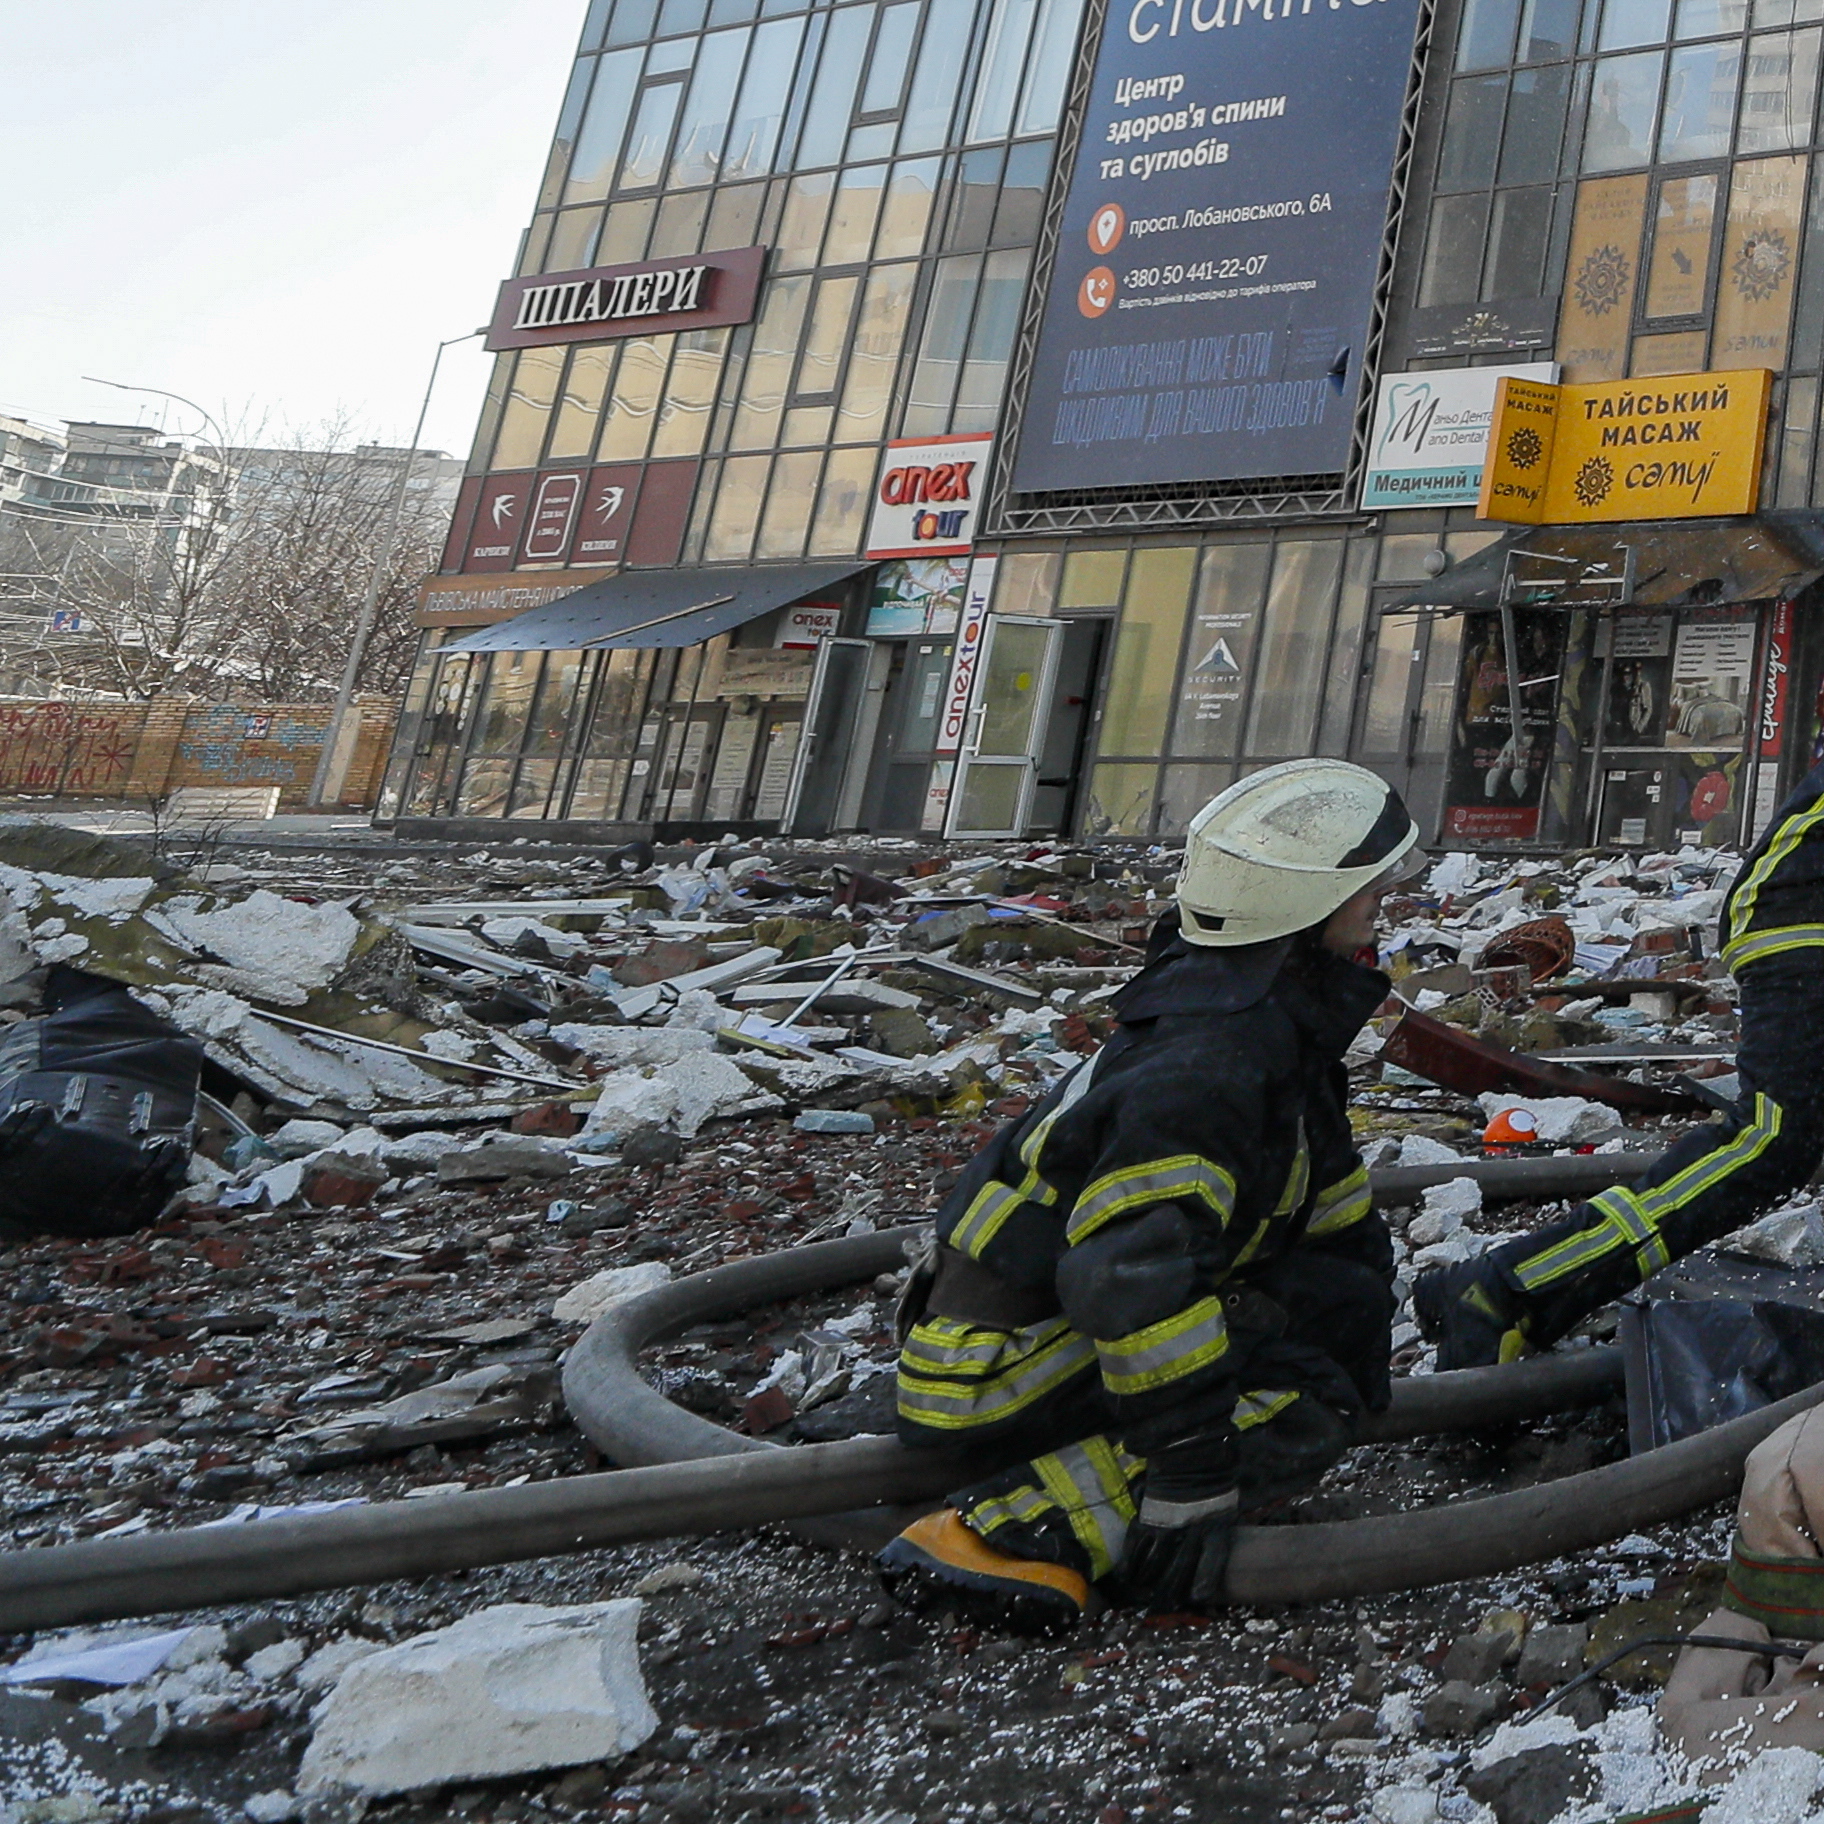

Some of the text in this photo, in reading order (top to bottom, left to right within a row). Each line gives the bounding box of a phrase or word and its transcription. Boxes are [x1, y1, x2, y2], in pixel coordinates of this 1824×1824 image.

[1114, 74, 1184, 107] Центр
[1106, 96, 1286, 145] здоров'я спини
[1100, 137, 1230, 181] та суглобів
[1129, 192, 1332, 239] просп. Лобановського, 6А
[1122, 254, 1269, 290] +380 50 441-22-07
[512, 265, 706, 330] ШПАЛЕРИ
[1186, 334, 1234, 382] МОЖЕ
[1233, 330, 1275, 379] БУТИ
[1506, 398, 1554, 417] МАСАЖ
[1508, 387, 1557, 402] ТАЙСЬКИЙ
[1584, 383, 1729, 420] ТАЙСЬКИЙ
[1145, 389, 1182, 444] ДЛЯ
[1182, 384, 1248, 435] ВАШОГО
[1449, 431, 1484, 445] Dental
[1601, 420, 1702, 447] МАСАЖ
[880, 460, 977, 506] anex
[1373, 473, 1468, 496] Медичний
[911, 509, 969, 541] tour
[423, 590, 478, 613] ЛЬВІВСЬКА
[793, 612, 834, 628] anex
[1187, 676, 1242, 684] SECURITY
